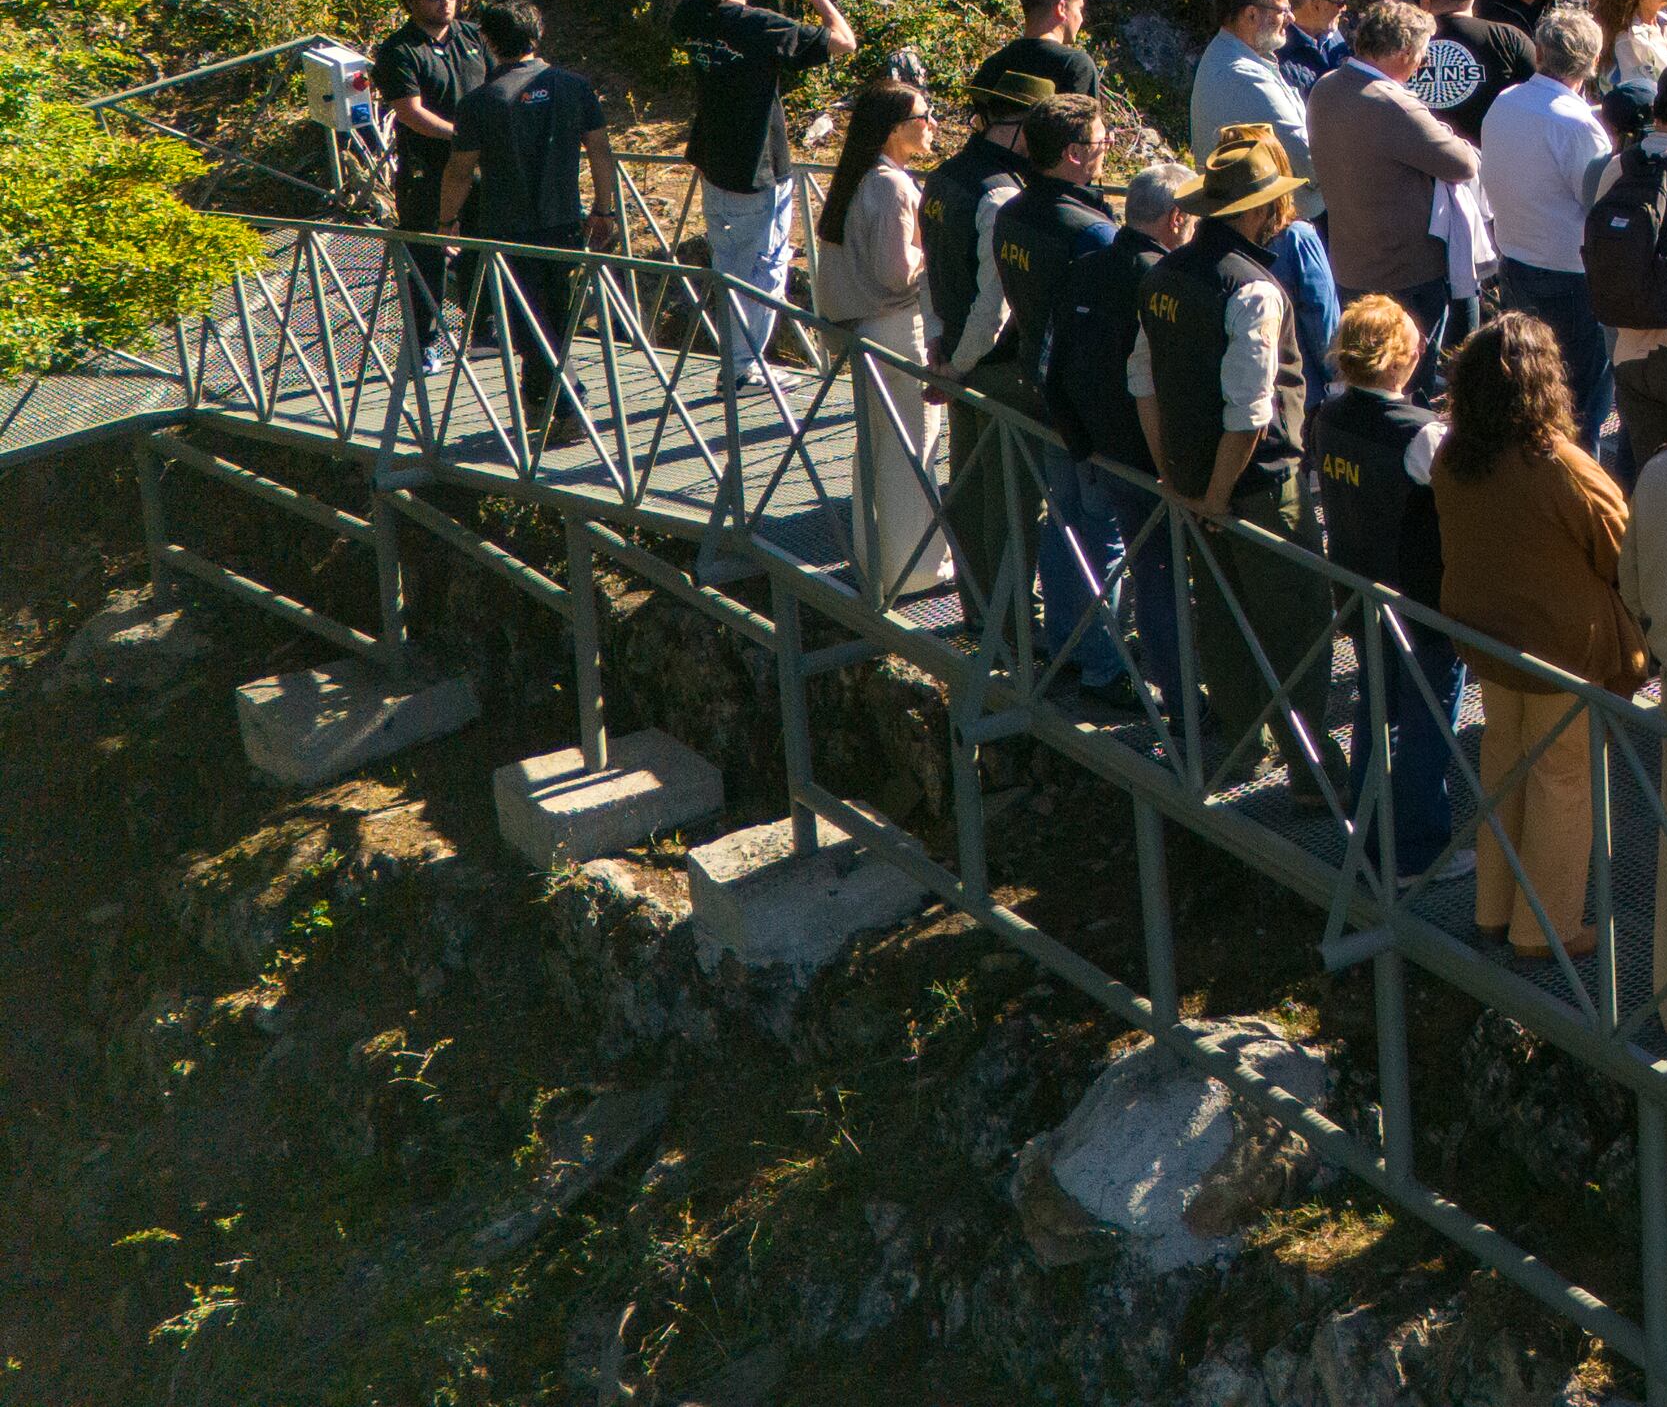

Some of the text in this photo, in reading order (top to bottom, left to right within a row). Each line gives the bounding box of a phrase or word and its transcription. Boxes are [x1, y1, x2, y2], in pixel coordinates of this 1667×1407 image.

[1417, 66, 1482, 83] ANS
[1000, 240, 1031, 272] APN
[1149, 291, 1180, 323] APN
[1322, 453, 1360, 488] APN
